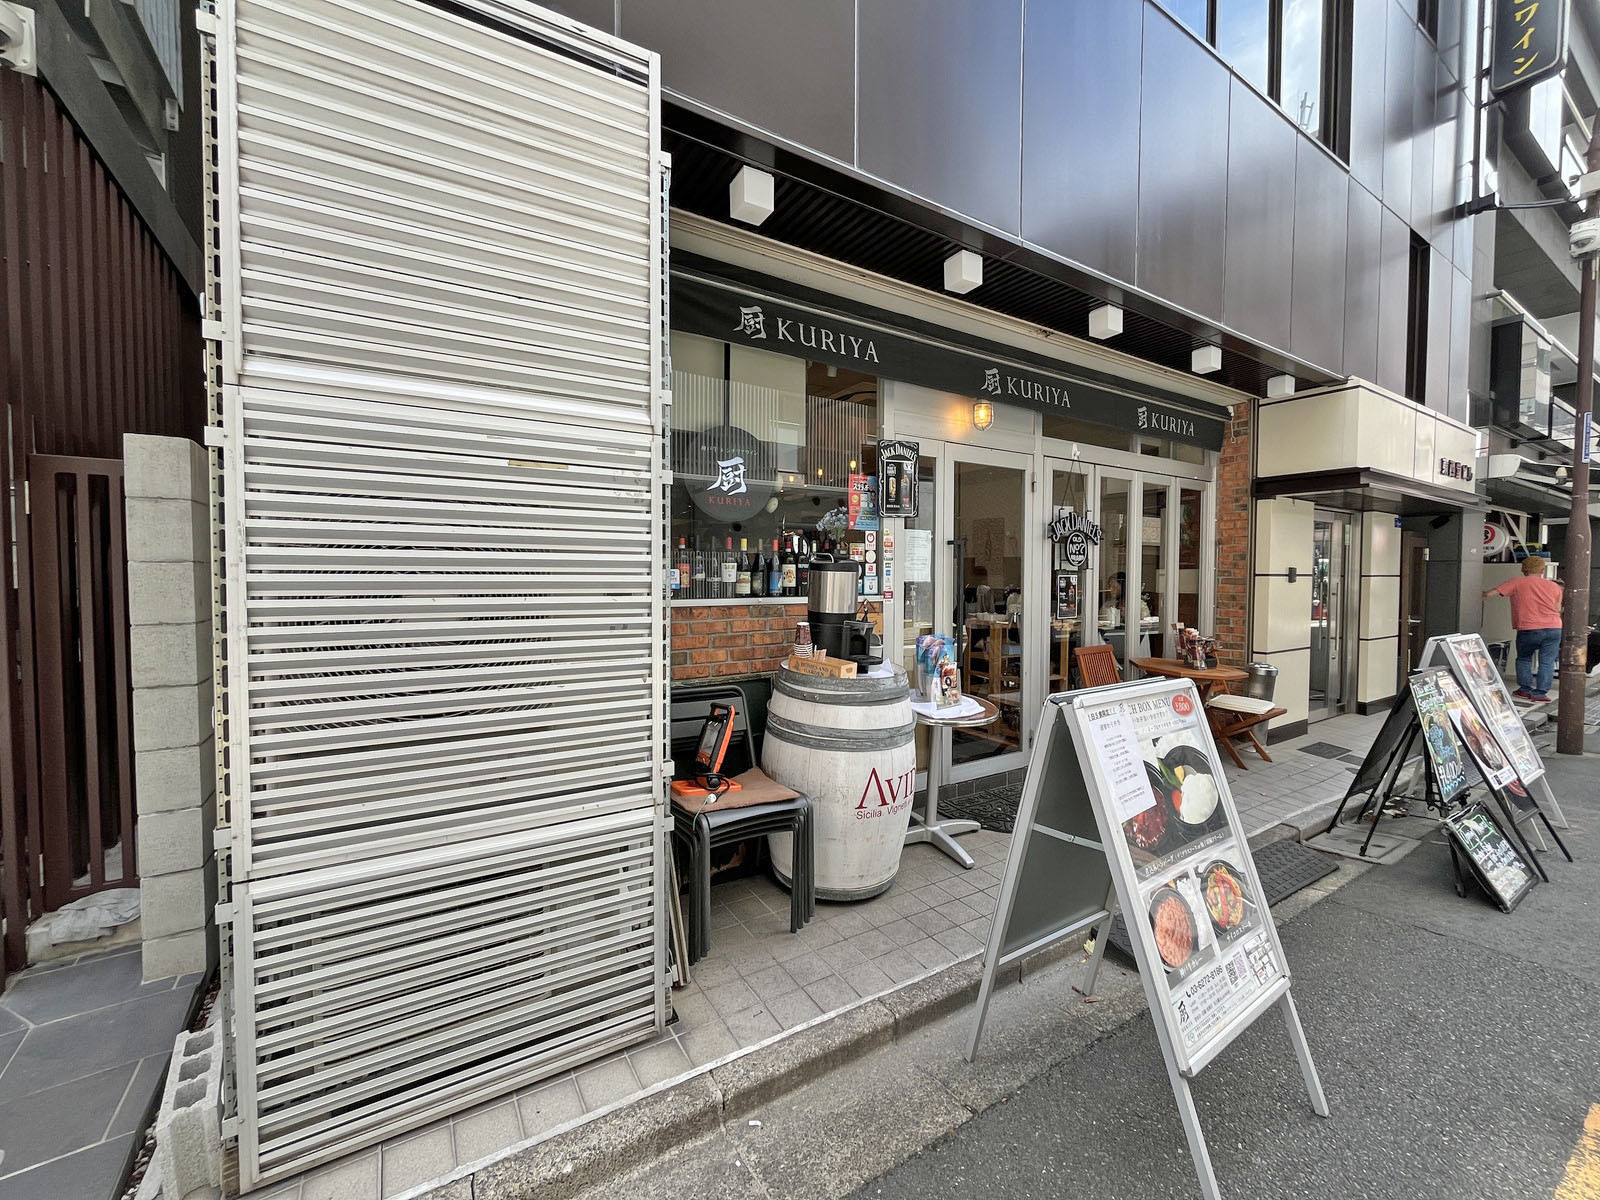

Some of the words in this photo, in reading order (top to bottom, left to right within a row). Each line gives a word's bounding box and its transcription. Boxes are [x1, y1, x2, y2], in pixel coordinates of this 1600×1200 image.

[776, 317, 880, 364] KURIYA
[1007, 376, 1071, 408] KURIYA
[1151, 412, 1195, 437] KURIYA
[708, 495, 751, 507] KURIYA
[1051, 517, 1071, 542] JACK
[1138, 701, 1150, 712] BOX
[1153, 697, 1171, 709] MENU
[856, 809, 882, 819] Sicilia
